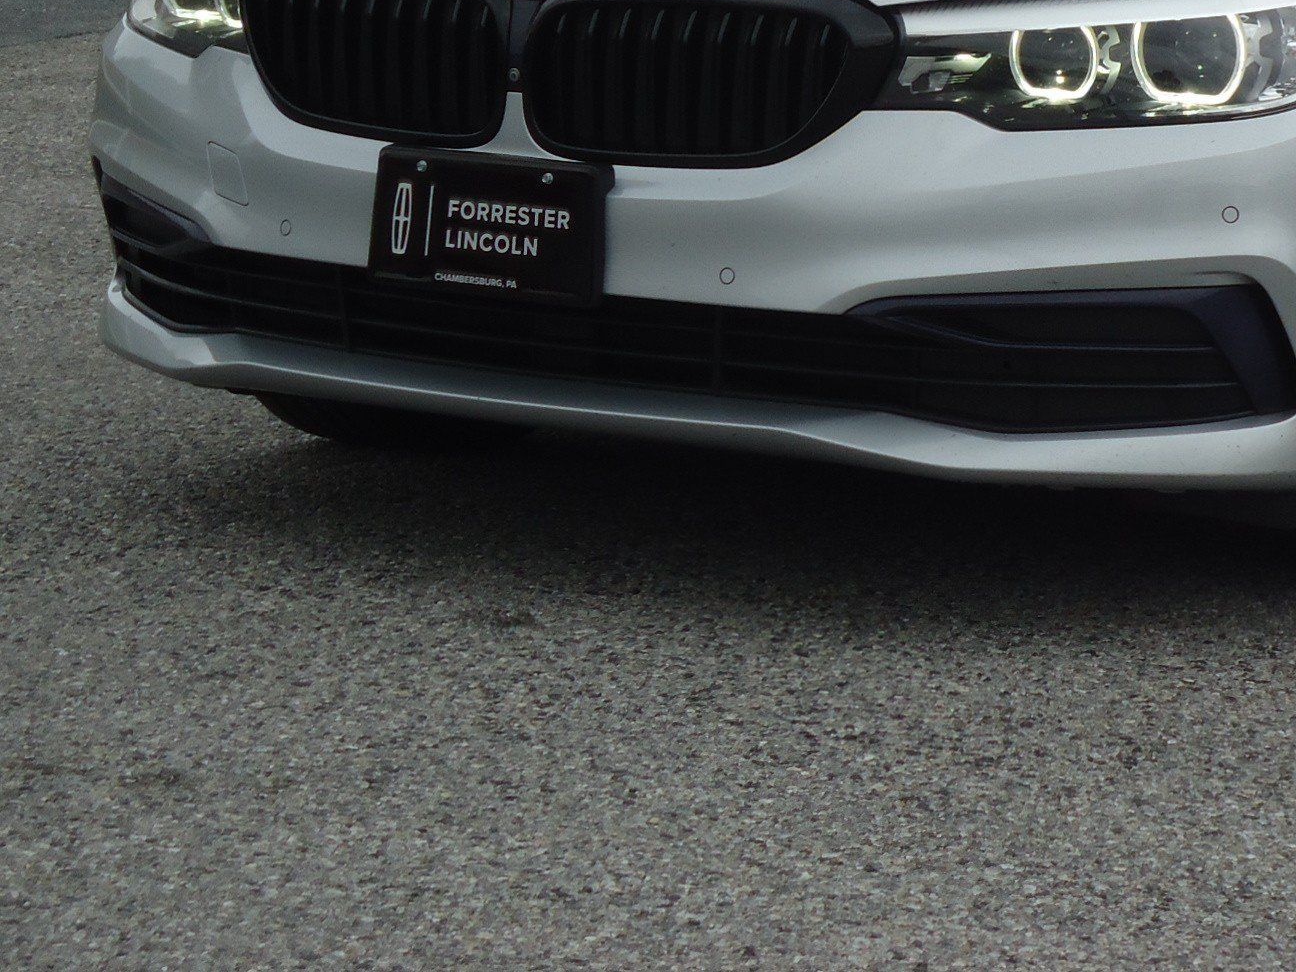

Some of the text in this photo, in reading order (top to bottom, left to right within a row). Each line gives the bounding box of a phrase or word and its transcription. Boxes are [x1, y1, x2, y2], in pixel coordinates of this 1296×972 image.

[447, 199, 571, 230] FORRESTER
[445, 229, 538, 257] LINCOLN
[434, 272, 517, 289] CHAMBERSBURG, PA
